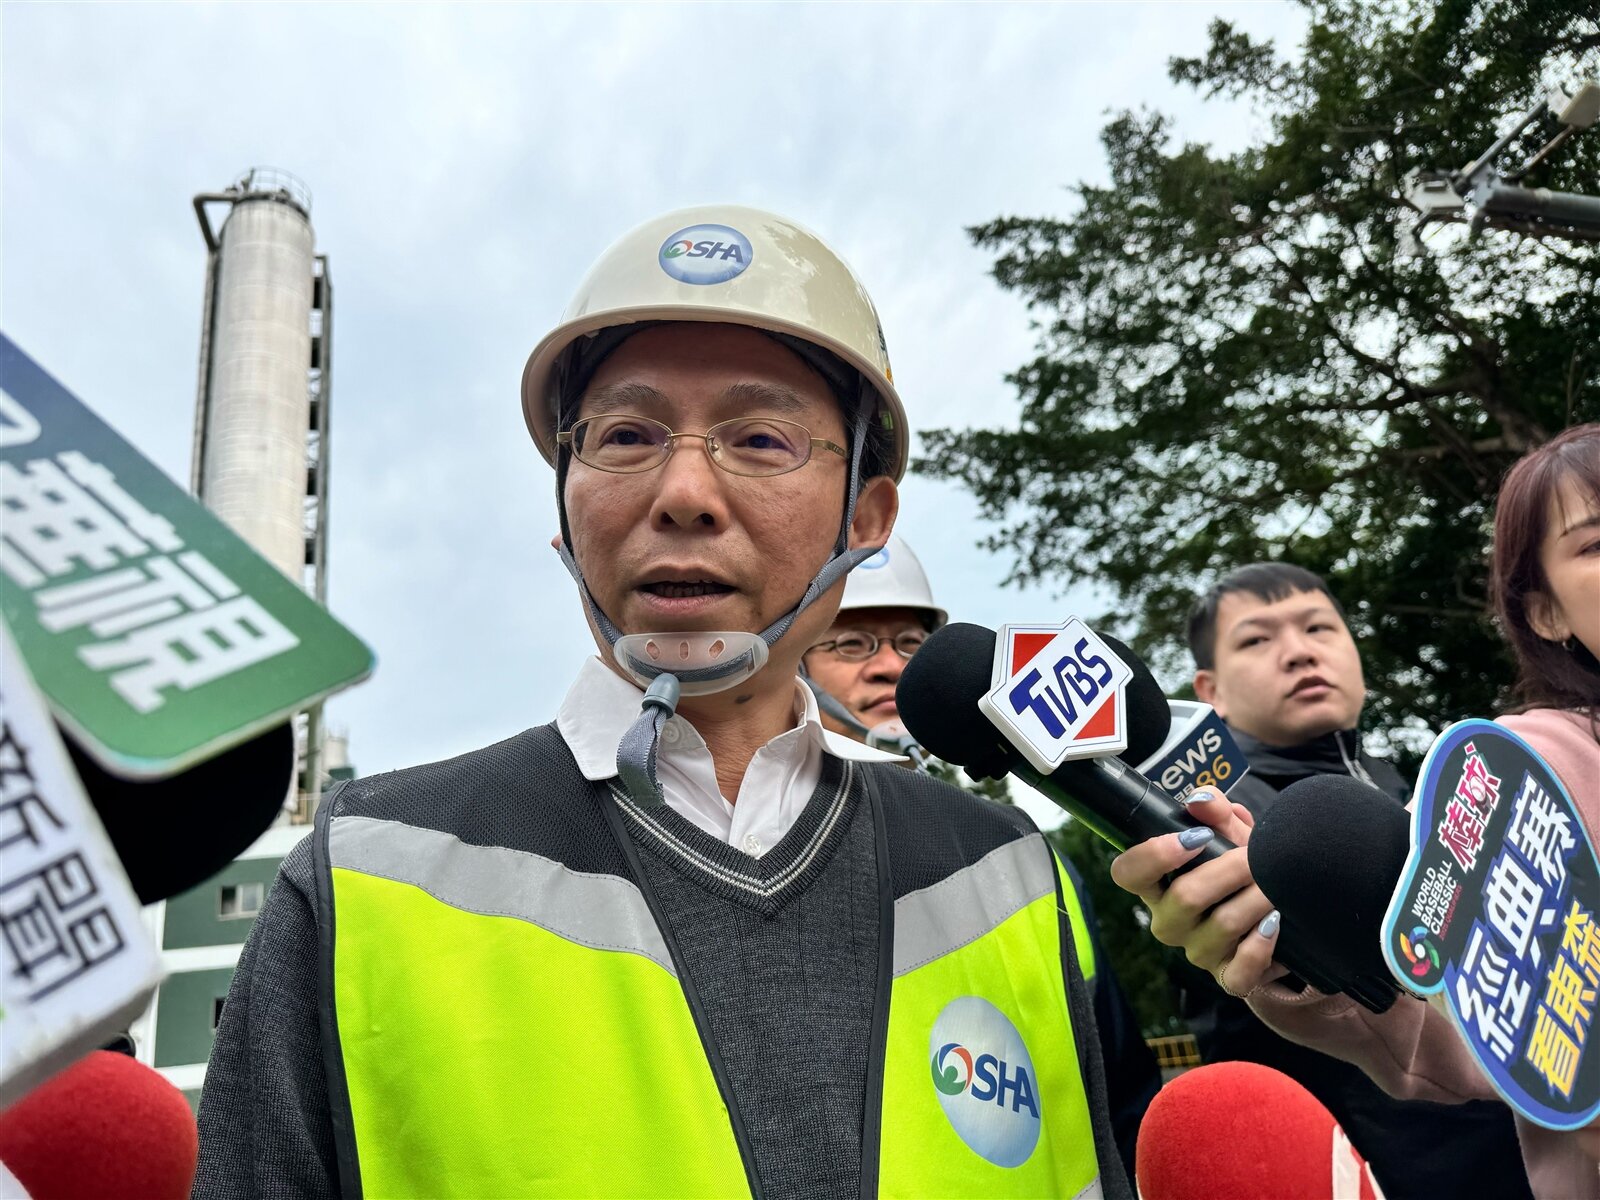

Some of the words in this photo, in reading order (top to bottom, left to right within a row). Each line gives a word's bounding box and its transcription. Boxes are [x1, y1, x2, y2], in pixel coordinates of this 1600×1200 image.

[663, 239, 744, 263] OSHA
[1009, 637, 1113, 739] TVBS
[1153, 728, 1222, 791] ews
[1438, 741, 1501, 874] 棒球
[1412, 867, 1436, 917] WORLD
[1421, 860, 1453, 928] BASEBALL
[1430, 876, 1458, 935] CLASSIC
[1456, 774, 1576, 1062] 經典賽
[931, 1043, 1040, 1119] OSHA
